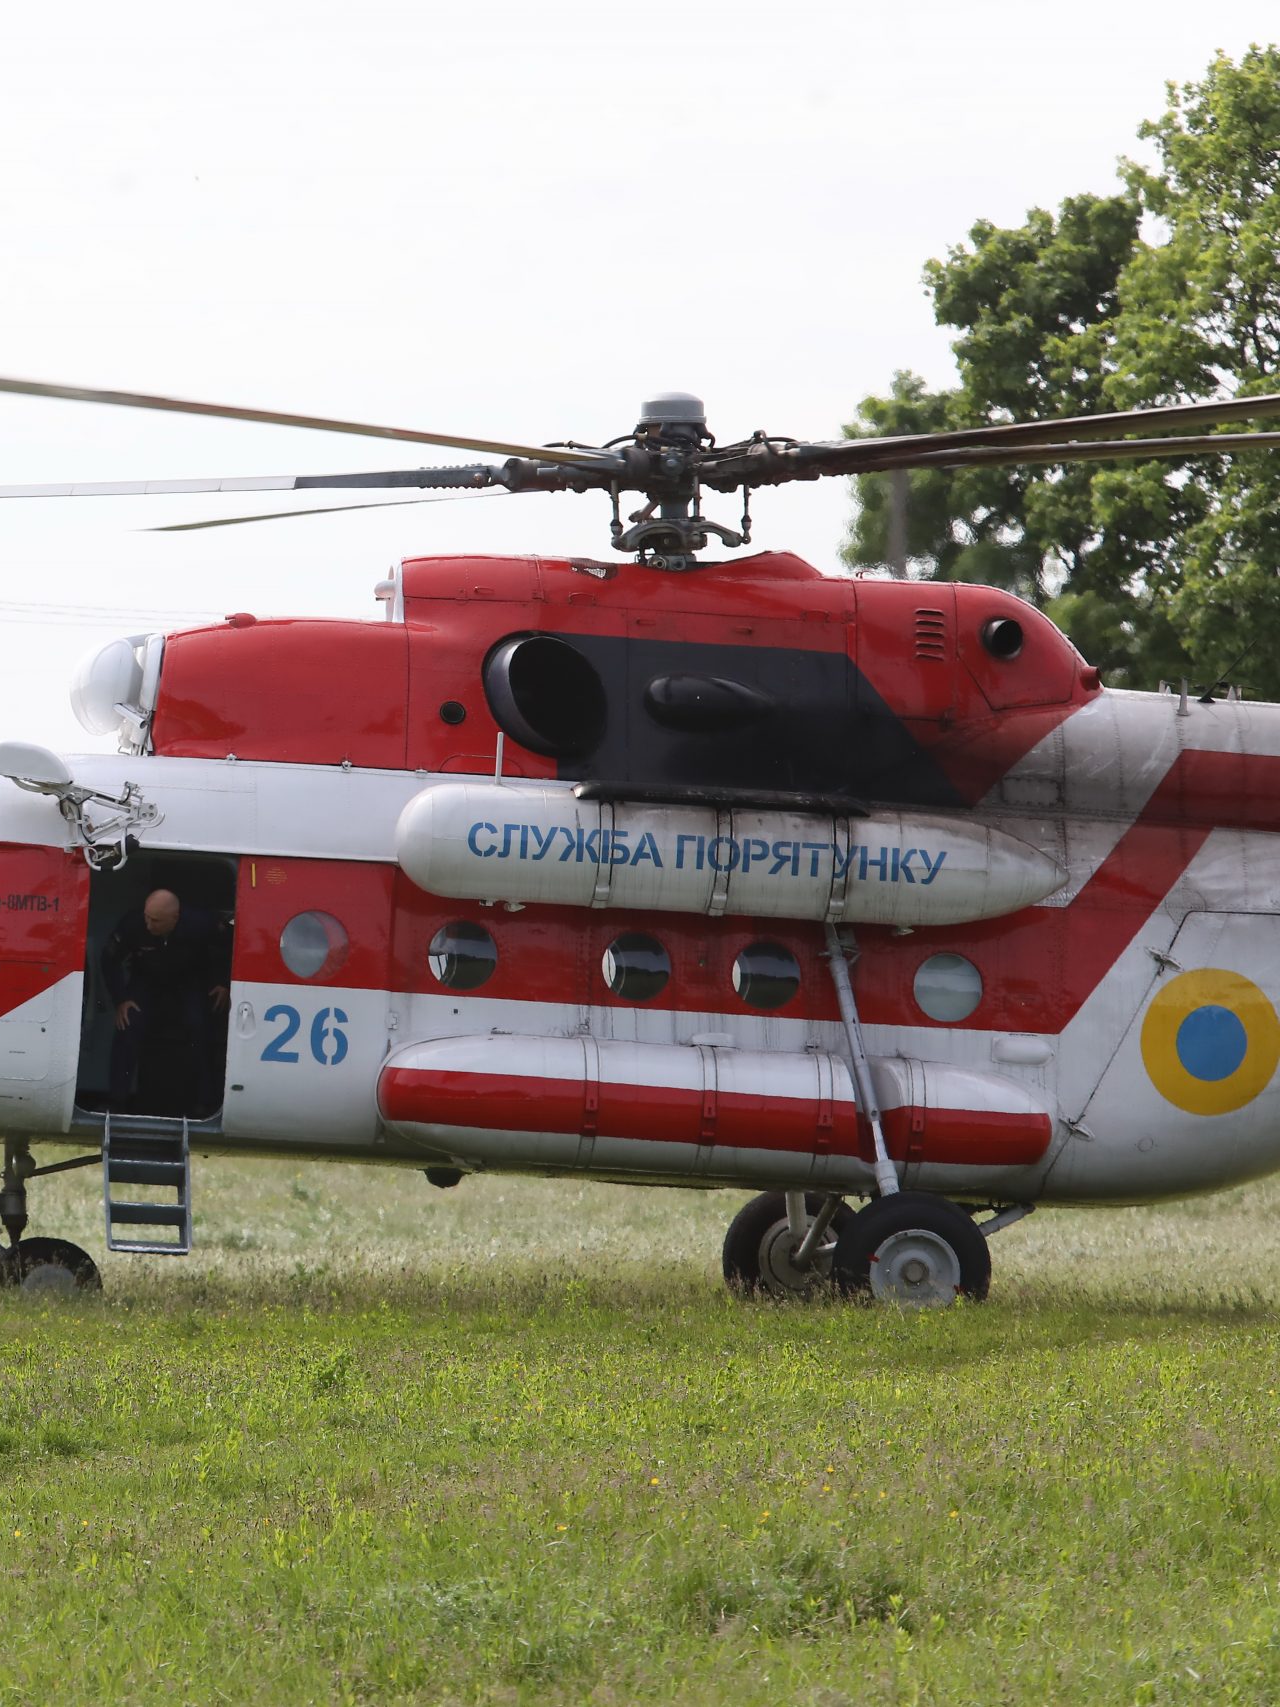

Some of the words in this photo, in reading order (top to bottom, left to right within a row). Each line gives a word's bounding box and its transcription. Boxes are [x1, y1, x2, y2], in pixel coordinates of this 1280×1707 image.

[467, 822, 663, 868] СЛУЖБА
[676, 834, 948, 885] ПОРЯТУНКУ
[260, 1004, 348, 1066] 26
